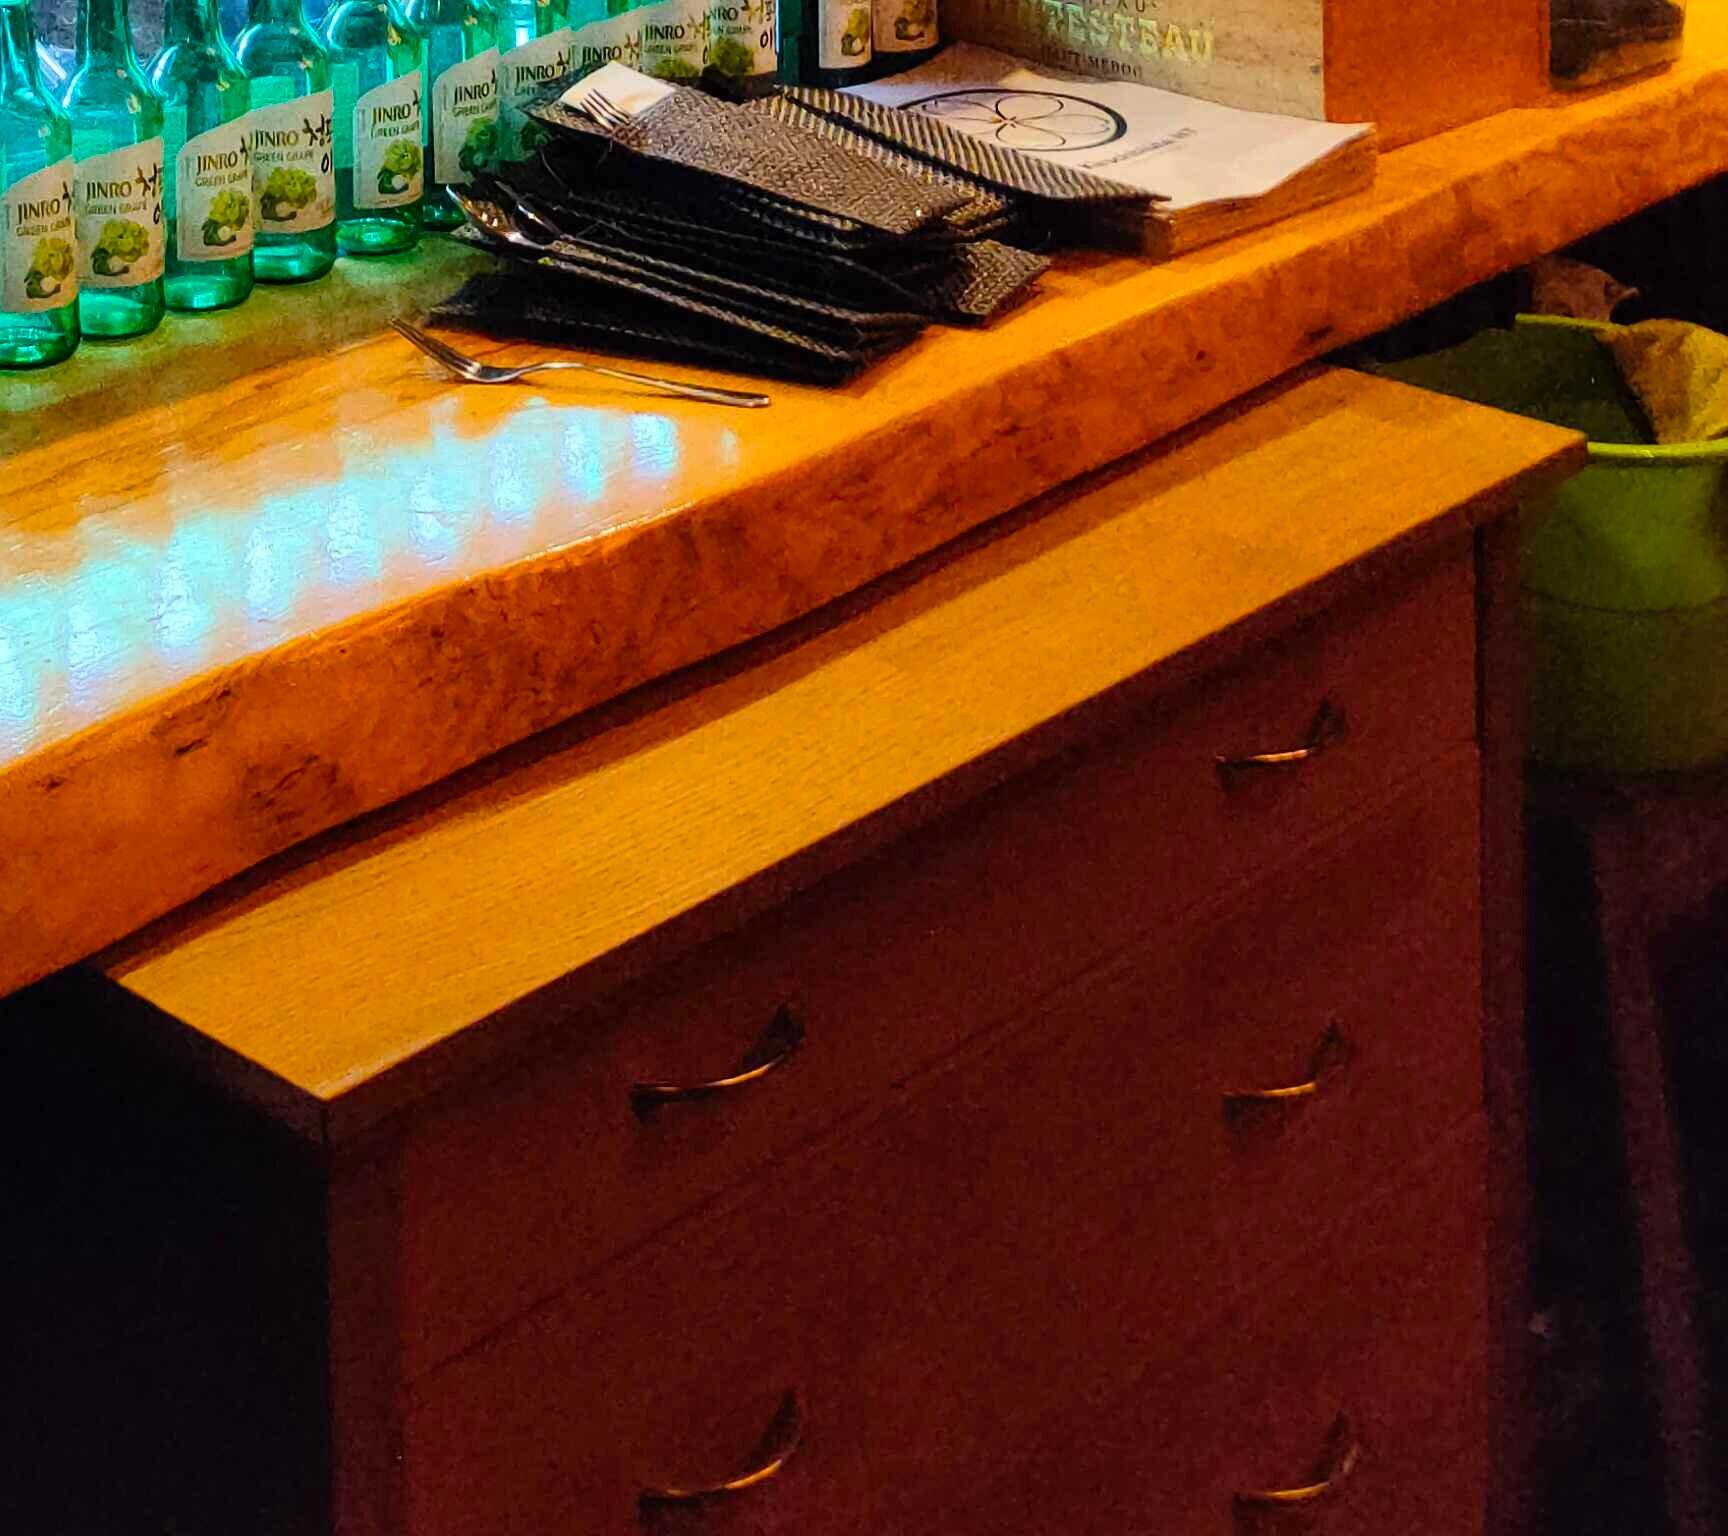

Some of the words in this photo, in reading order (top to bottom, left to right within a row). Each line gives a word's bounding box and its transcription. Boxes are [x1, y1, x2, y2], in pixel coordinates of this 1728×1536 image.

[582, 46, 622, 66] JINRO
[515, 64, 555, 85] JINRO
[453, 82, 490, 106] JINRO
[371, 103, 411, 128] JINRO
[254, 128, 299, 150] JINRO
[197, 149, 239, 176] JINRO
[86, 180, 132, 203] JINRO
[17, 197, 61, 226] JINRO
